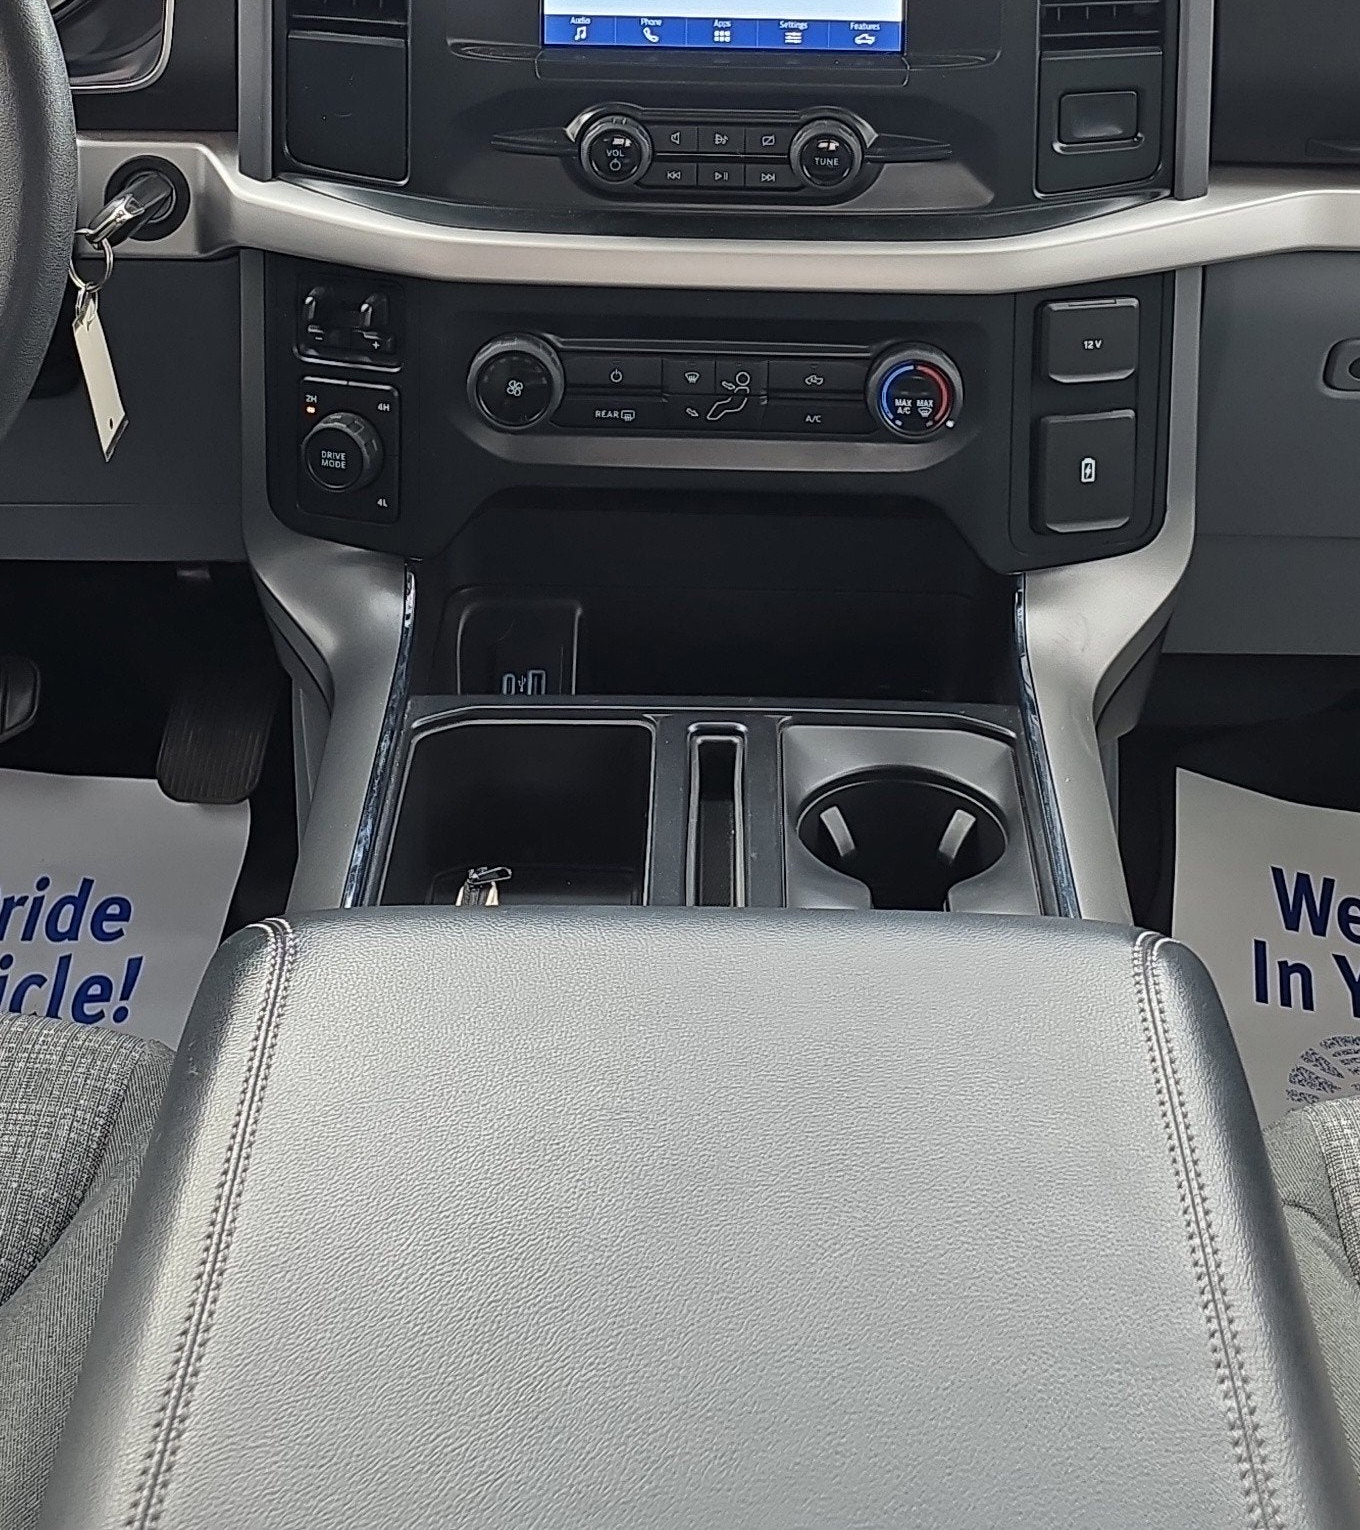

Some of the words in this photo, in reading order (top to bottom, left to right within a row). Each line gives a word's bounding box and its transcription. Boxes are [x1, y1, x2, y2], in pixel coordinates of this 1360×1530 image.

[570, 17, 591, 25] Audio
[640, 18, 662, 26] Phone
[713, 20, 731, 29] Apps
[779, 21, 808, 30] Settings
[849, 22, 880, 31] Features
[606, 149, 624, 158] VOL
[814, 157, 839, 166] TUNE
[1083, 340, 1094, 350] 12
[305, 395, 318, 403] 2H
[894, 398, 912, 407] MAX
[916, 398, 934, 407] MAX
[378, 403, 390, 411] 4H
[897, 406, 911, 415] A/C
[595, 409, 619, 419] REAR
[805, 414, 822, 423] A/C
[321, 450, 346, 461] DRIVE
[321, 459, 346, 469] MODE
[377, 498, 388, 508] 4L
[1252, 938, 1316, 1013] In
